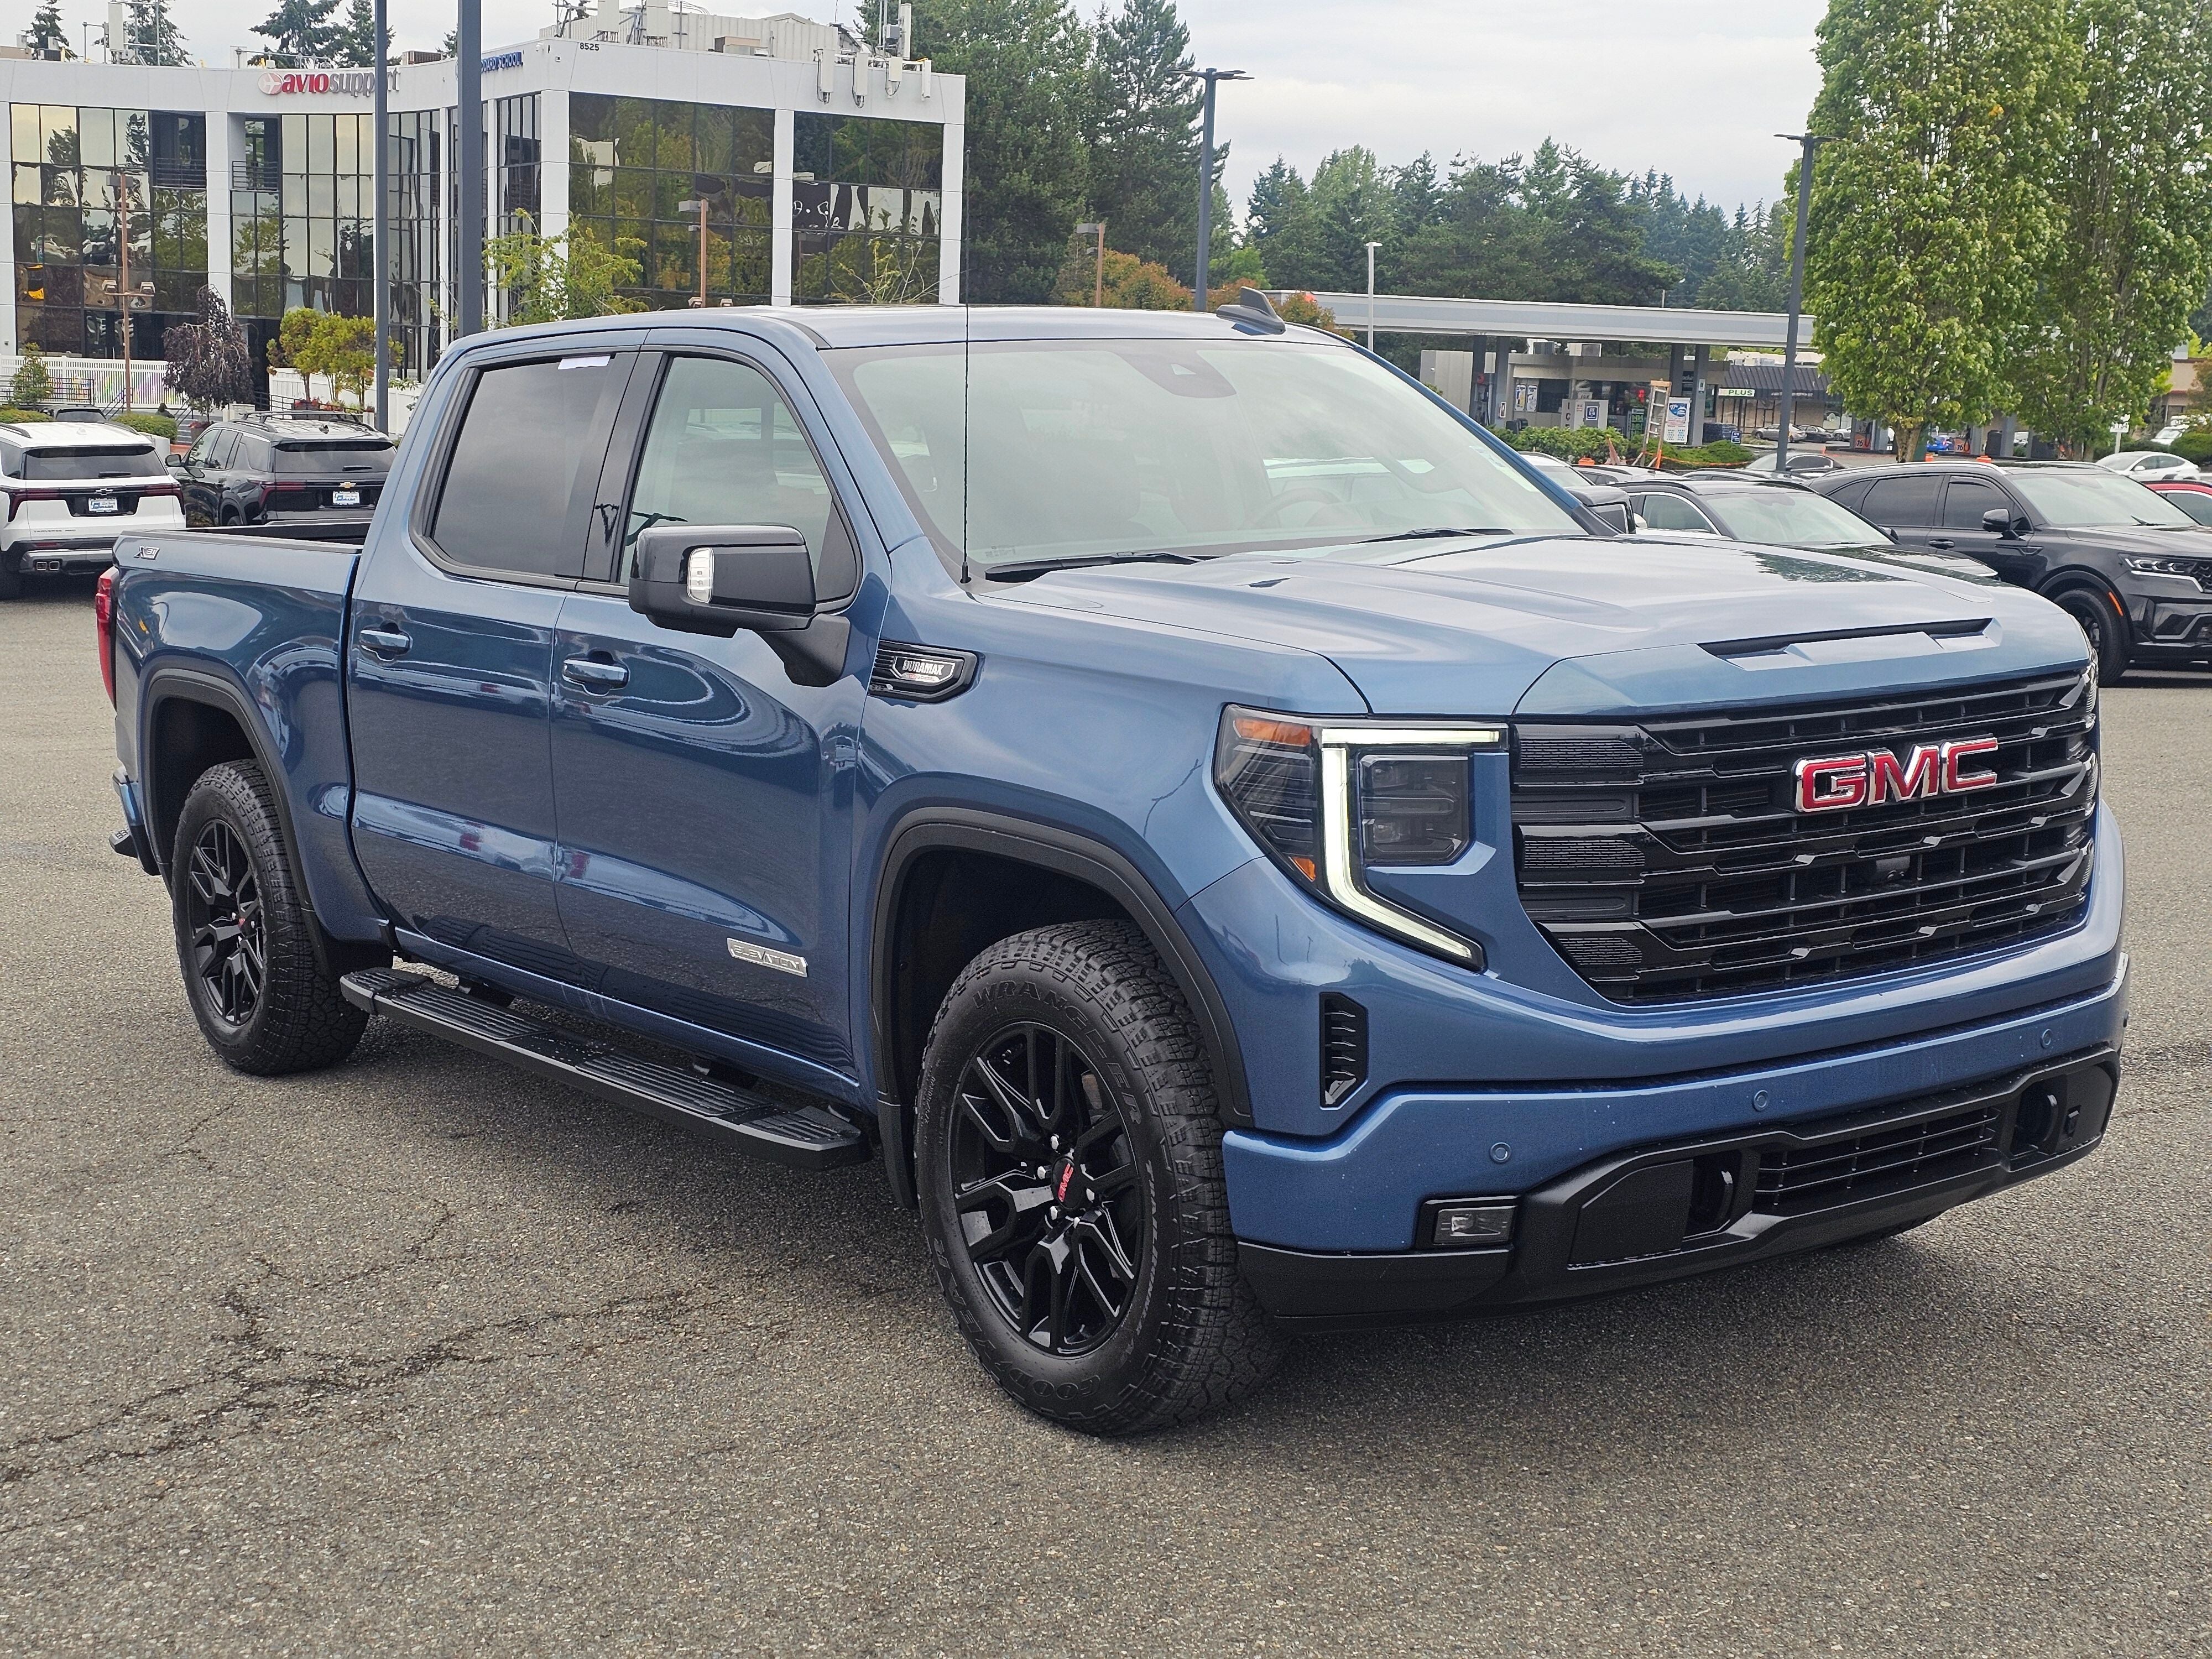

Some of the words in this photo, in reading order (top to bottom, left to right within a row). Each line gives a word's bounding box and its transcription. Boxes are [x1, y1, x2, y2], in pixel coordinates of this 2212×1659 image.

[580, 42, 599, 51] 8525
[498, 52, 521, 69] SCHOOL
[282, 67, 401, 97] aviosupprt
[902, 659, 945, 676] DURAMAX
[1794, 737, 2000, 813] GMC
[733, 945, 800, 969] ELEVATION
[972, 980, 1142, 1125] WRANGLER
[1057, 1162, 1074, 1202] GMC
